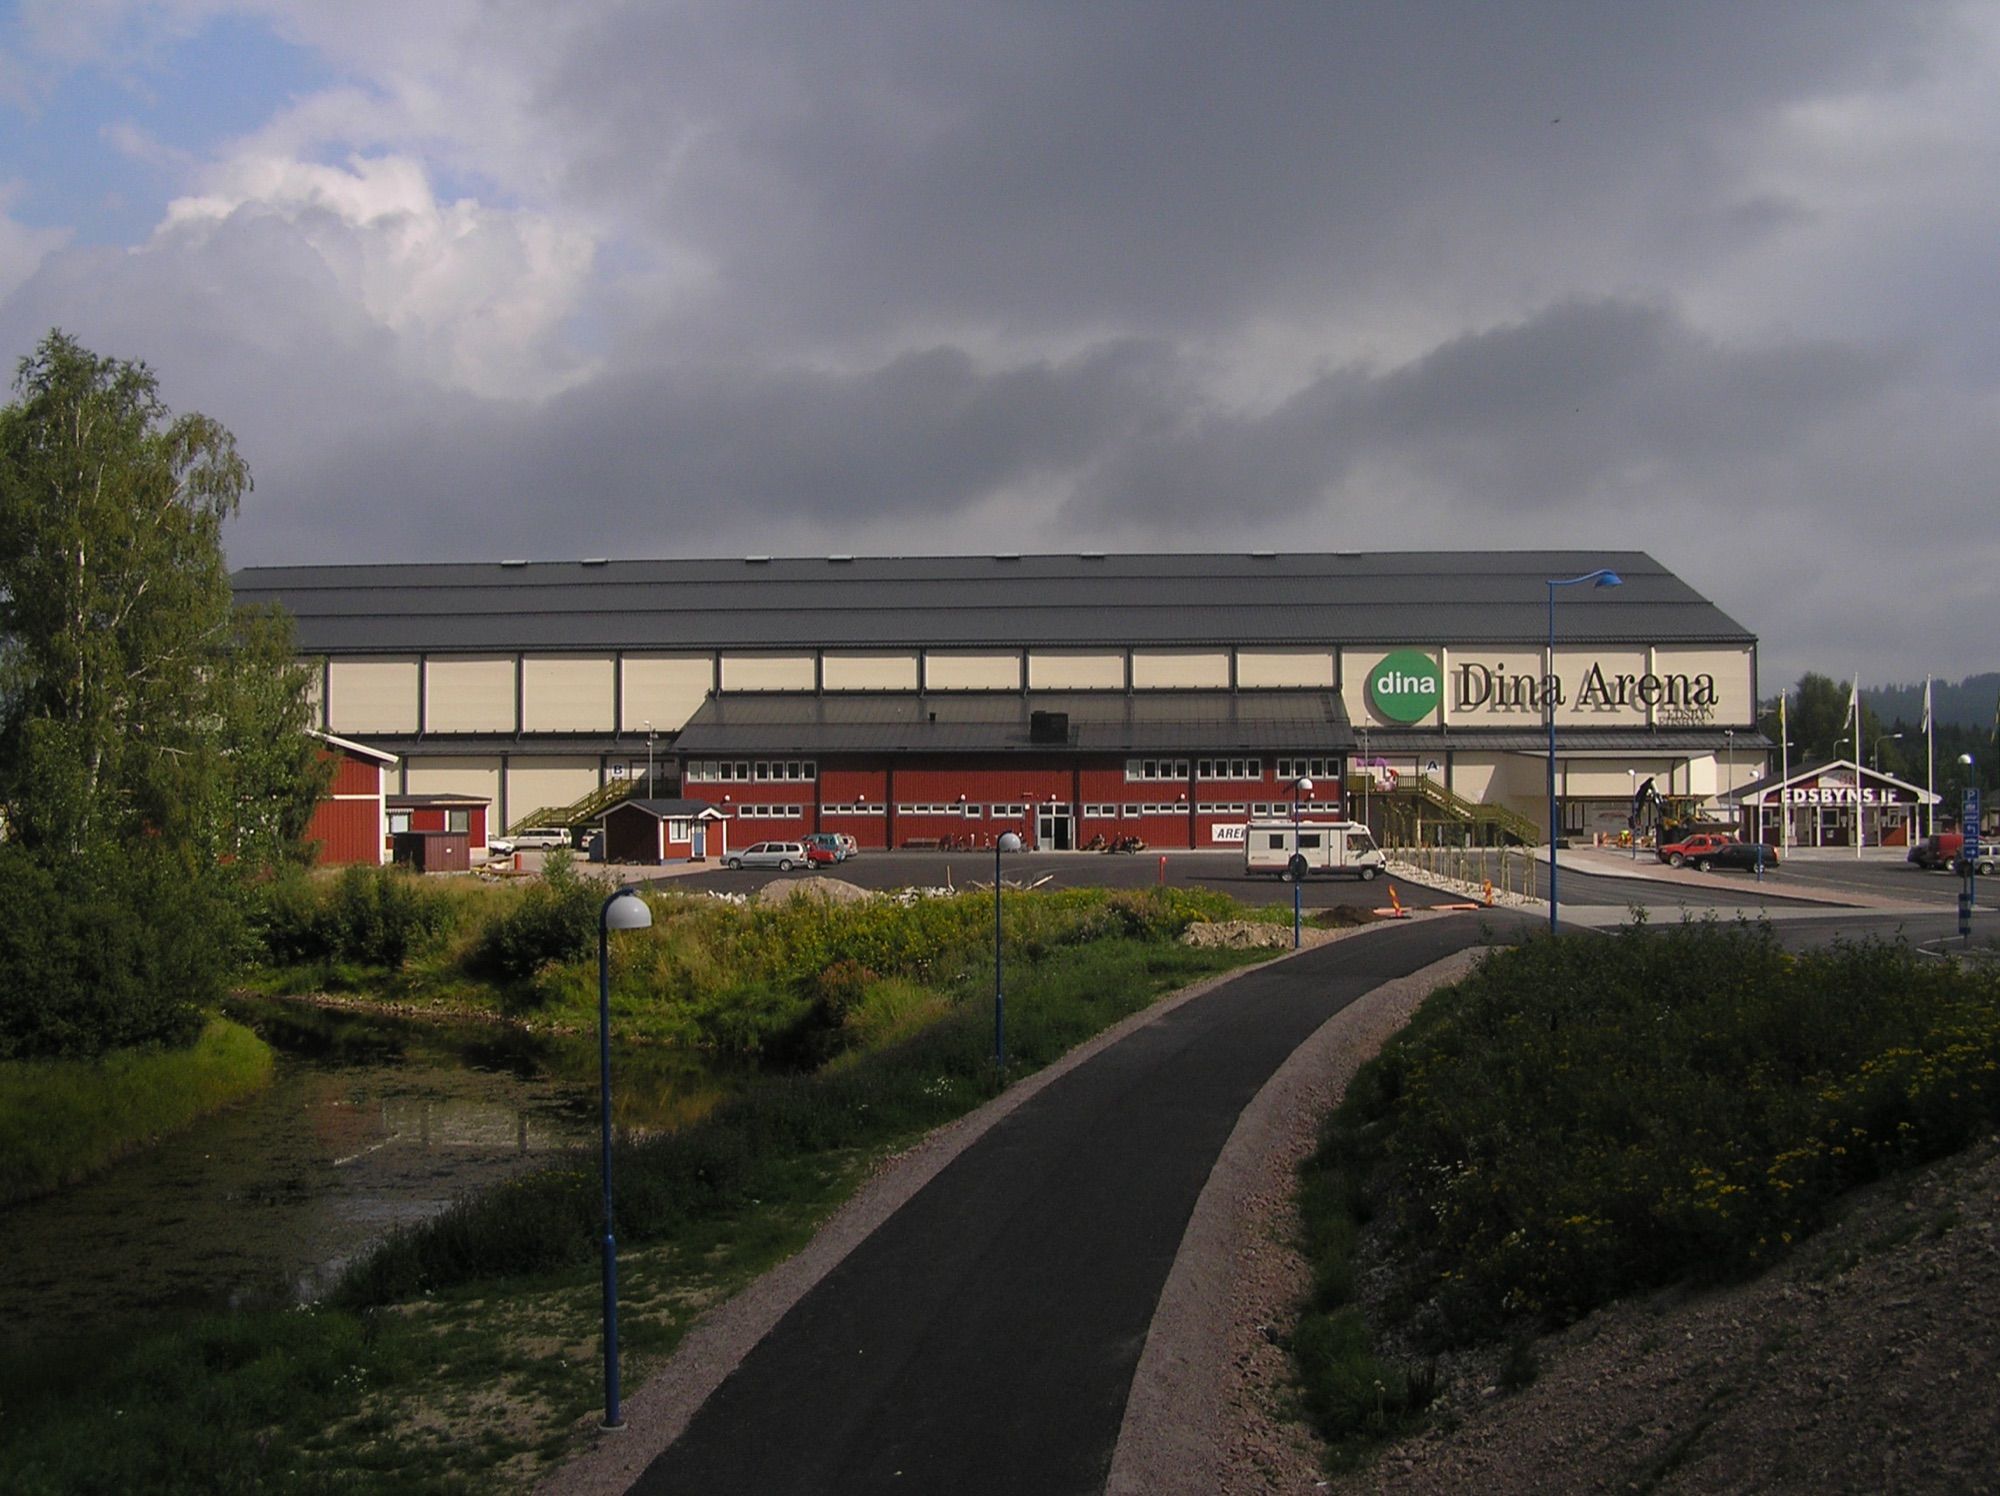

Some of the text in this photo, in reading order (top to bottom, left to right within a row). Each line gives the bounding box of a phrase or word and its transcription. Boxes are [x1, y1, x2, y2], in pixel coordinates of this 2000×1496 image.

[1377, 671, 1435, 695] dina
[1459, 661, 1719, 706] Dina Arena
[614, 764, 622, 774] B
[1427, 760, 1438, 771] A
[1781, 788, 1898, 804] EDSBYNS IF
